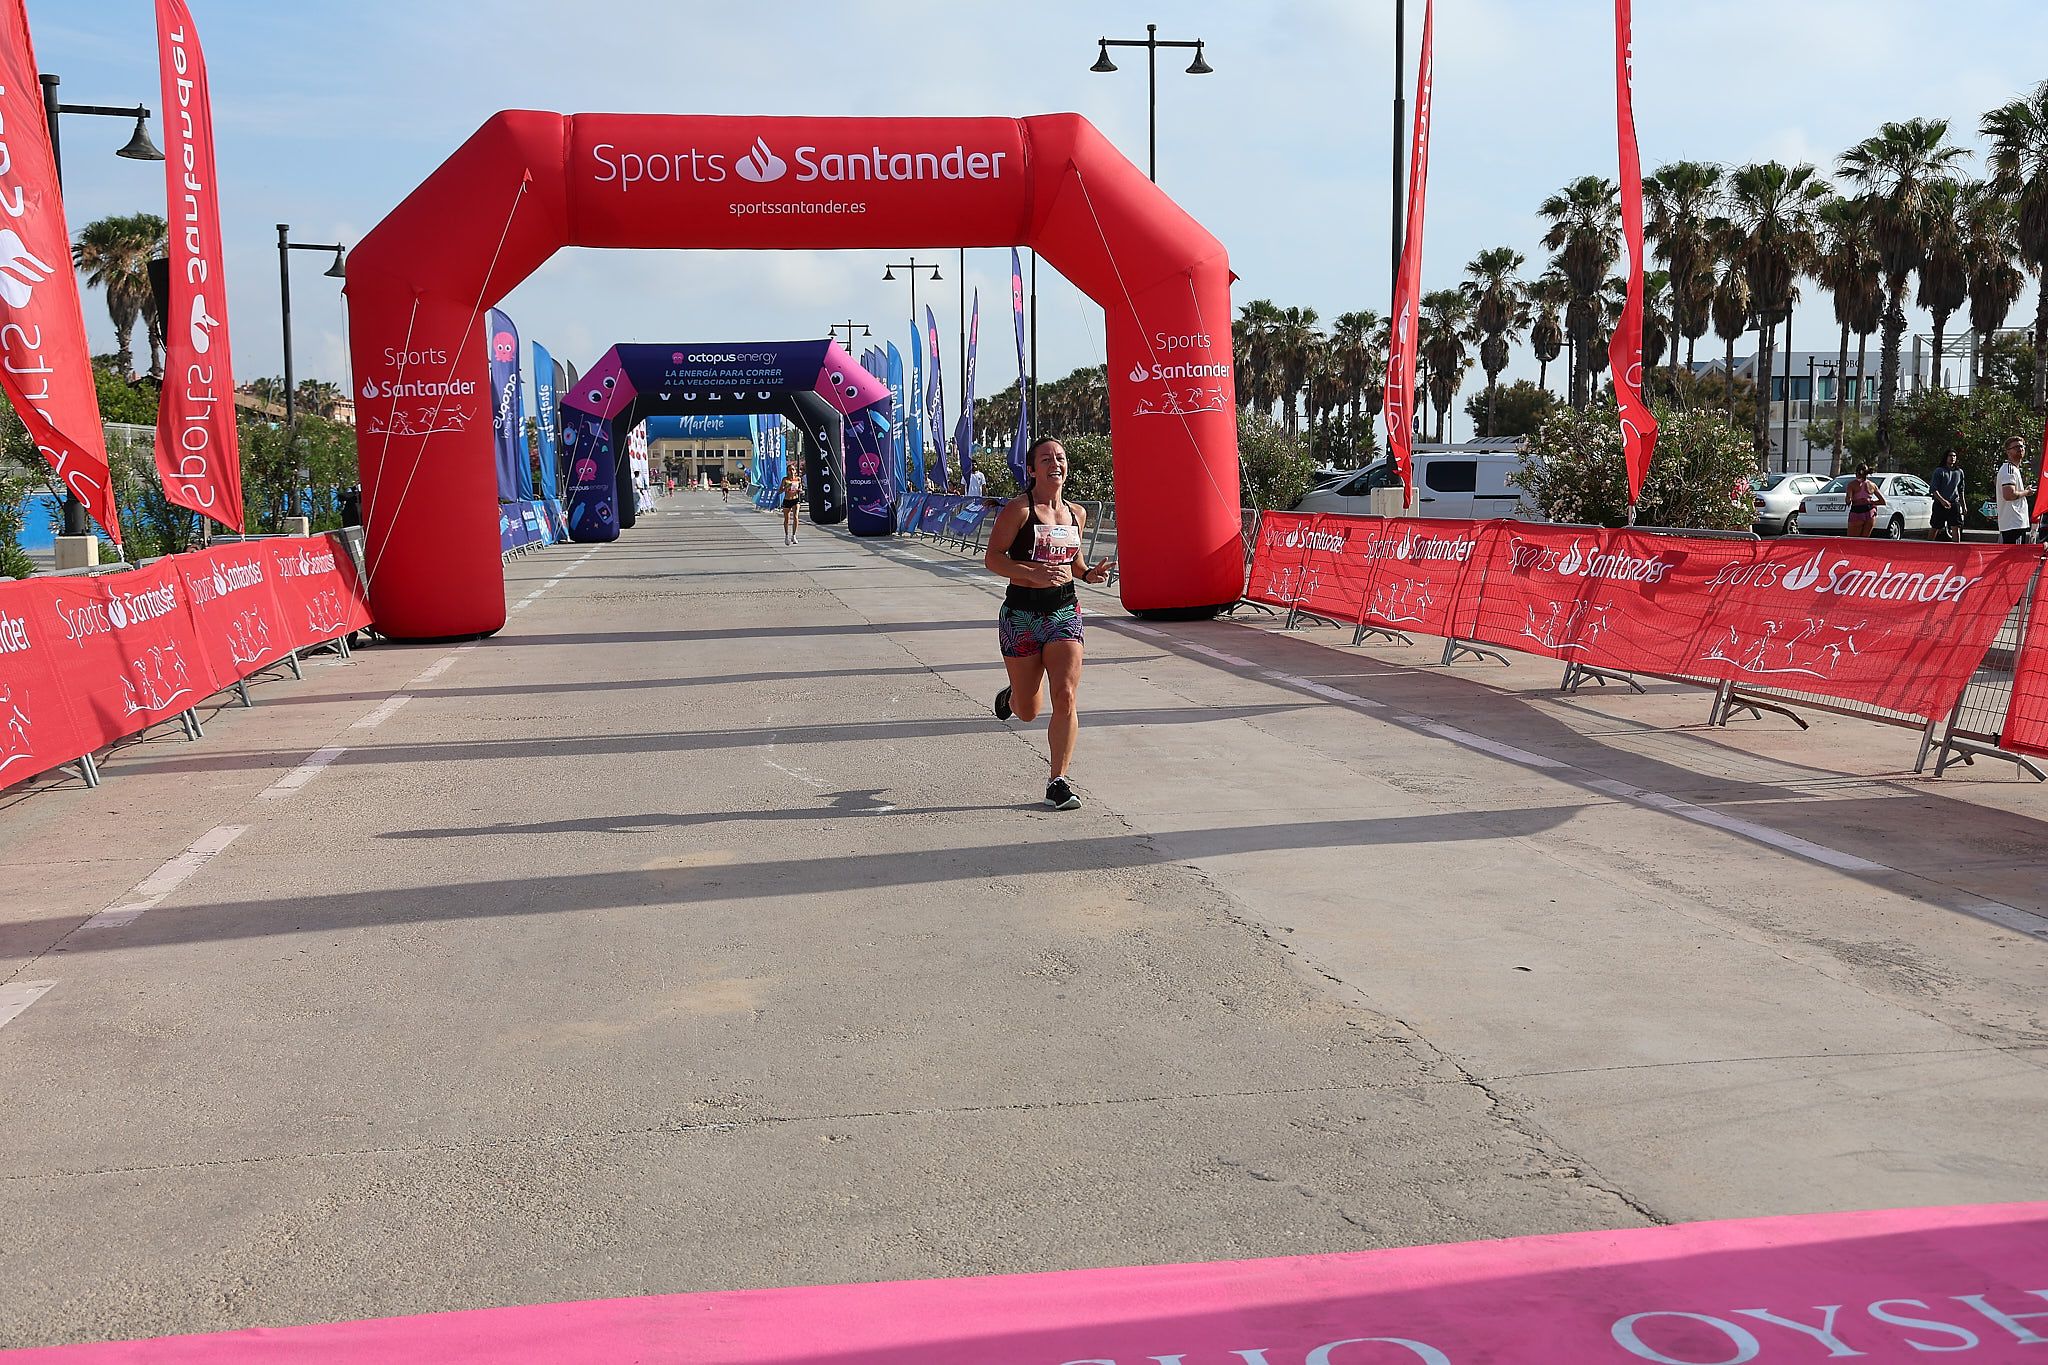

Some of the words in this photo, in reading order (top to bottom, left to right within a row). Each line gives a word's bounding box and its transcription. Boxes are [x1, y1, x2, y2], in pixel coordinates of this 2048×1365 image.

[592, 143, 727, 192] Sports
[794, 145, 1006, 181] Santander
[729, 201, 866, 217] sportssantander.es
[1155, 332, 1211, 353] Sports
[384, 347, 447, 370] Sports
[688, 353, 737, 364] octopus
[737, 352, 777, 365] energy
[679, 368, 717, 377] ENERGÍA
[720, 369, 744, 377] PARA
[1151, 362, 1230, 380] Santander
[381, 378, 476, 398] Santander
[1363, 532, 1397, 565] Sports
[1408, 533, 1476, 562] Santander
[1509, 536, 1560, 575] Sports
[1579, 545, 1674, 584] Santander
[186, 573, 216, 612] Sports
[221, 558, 264, 592] Santander
[1705, 560, 1788, 593] Sports
[1813, 559, 1983, 603] Santander
[55, 598, 111, 649] Sports
